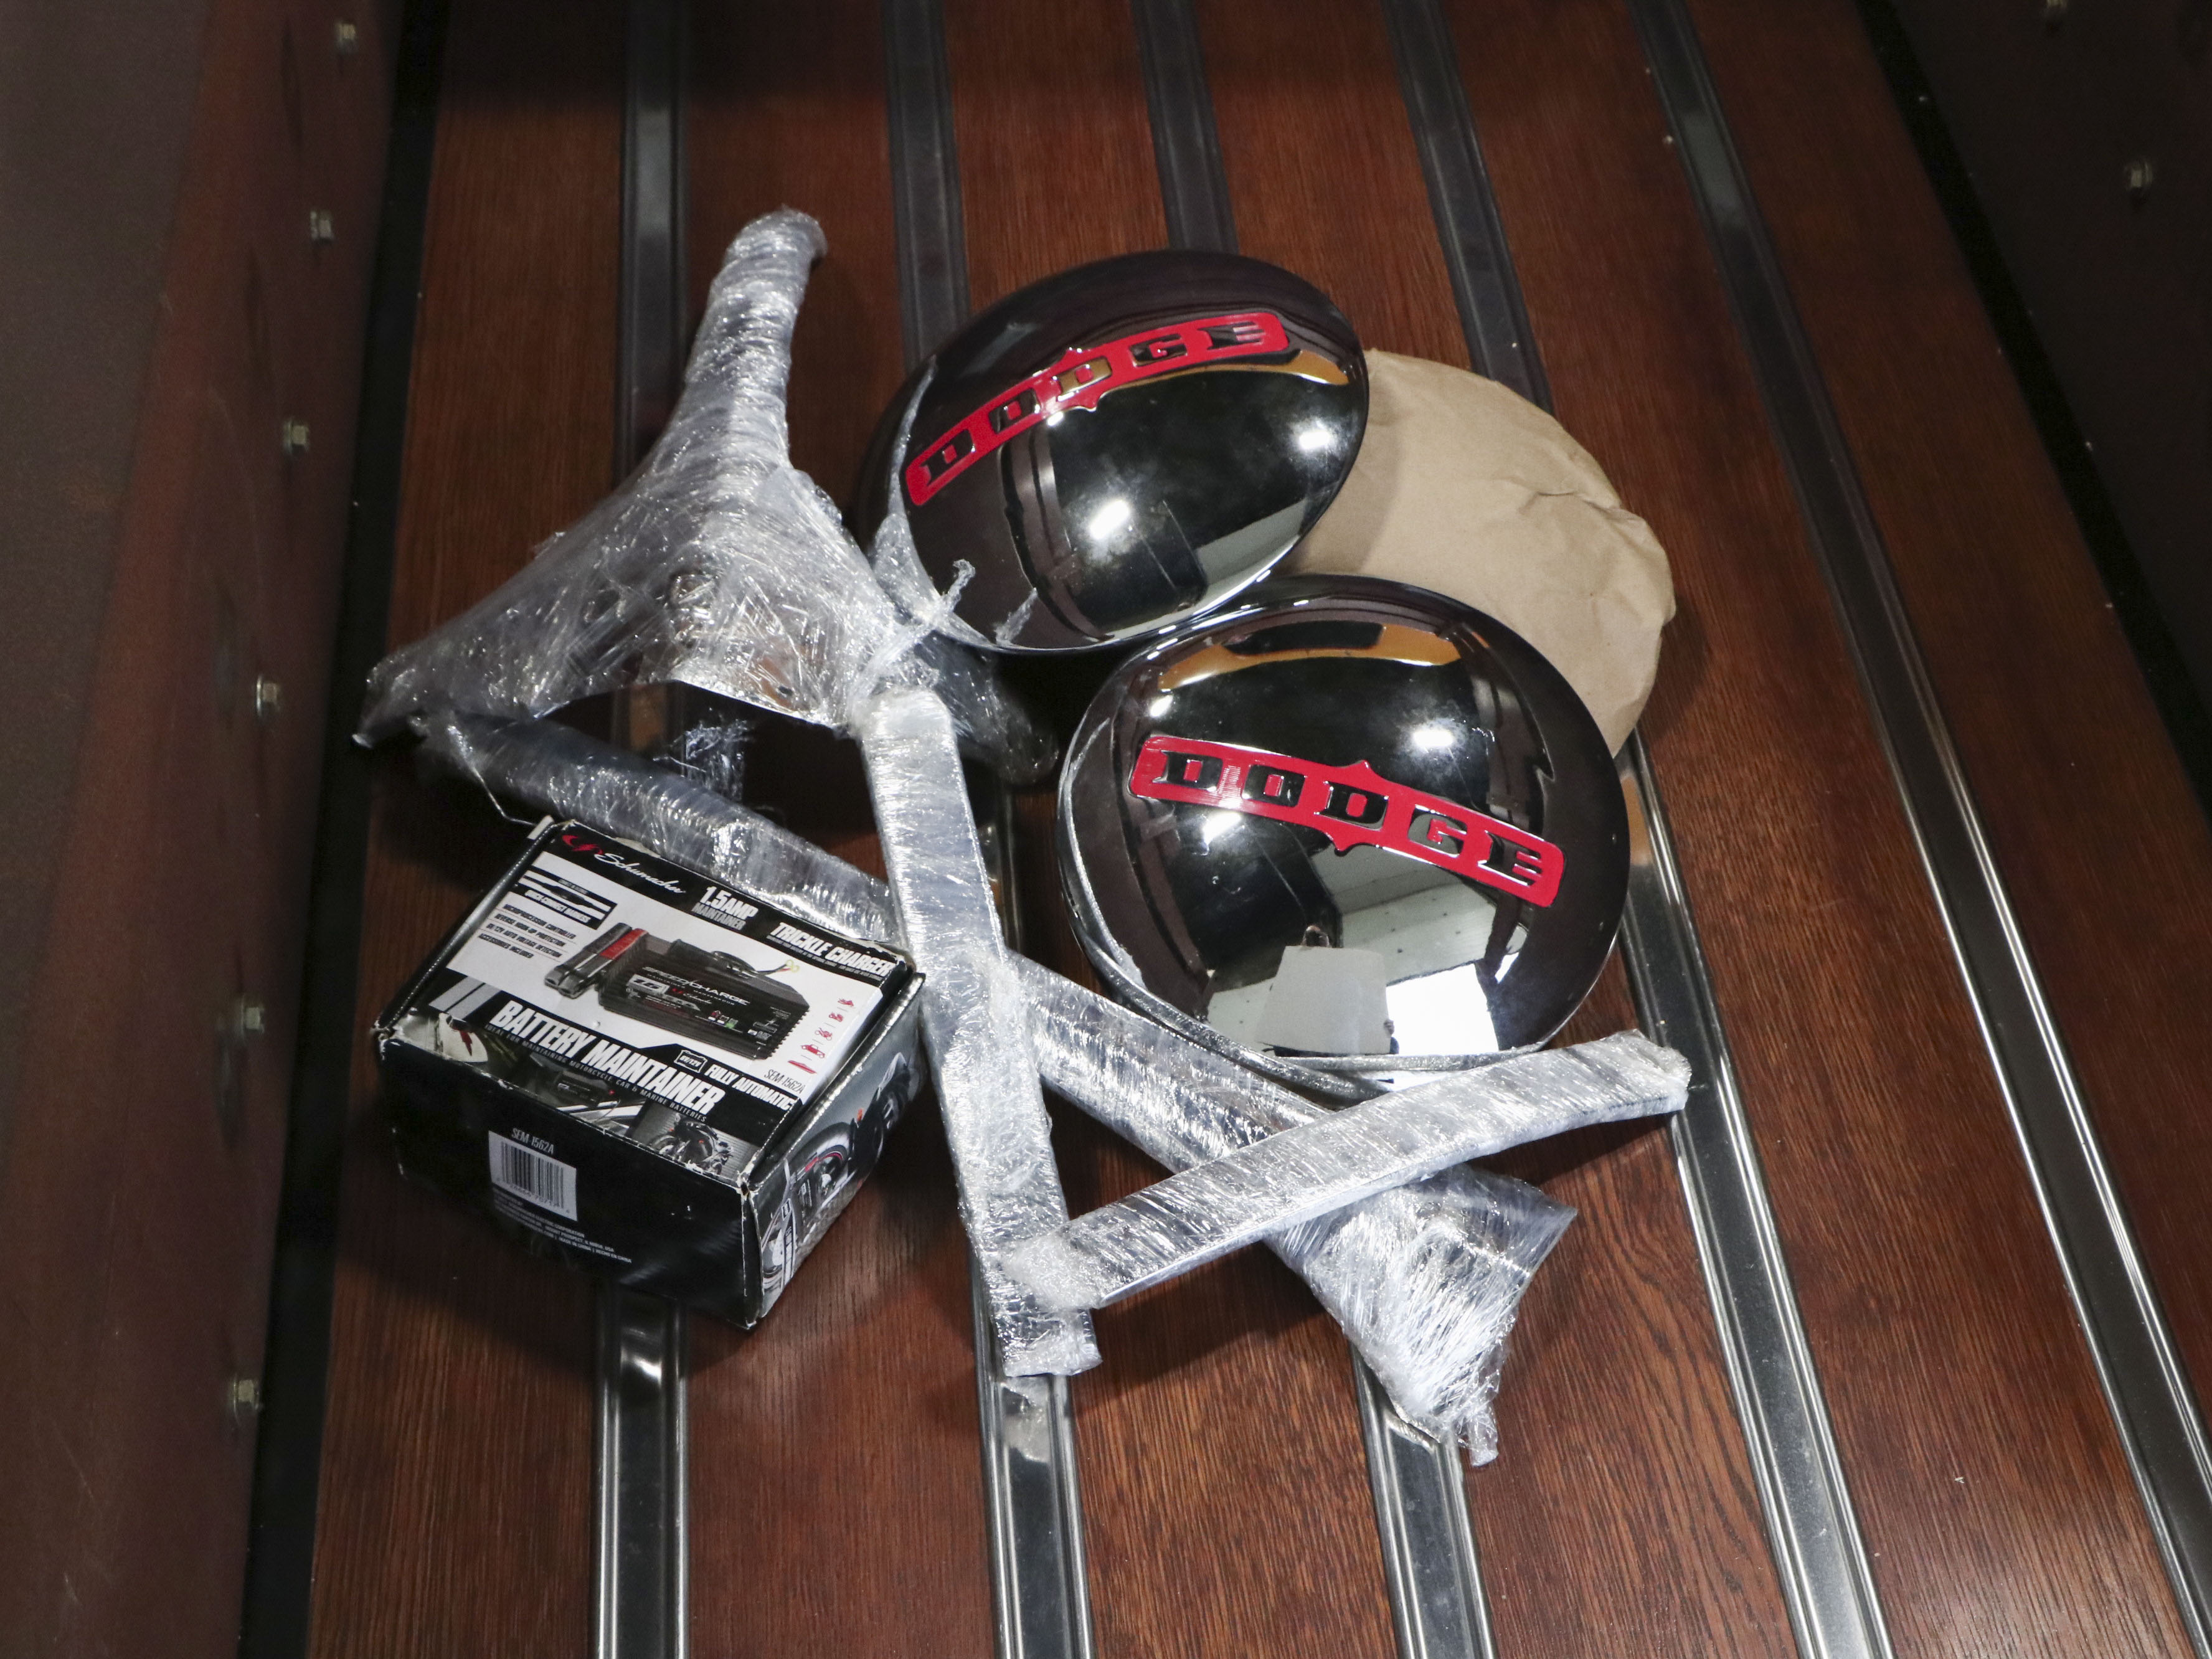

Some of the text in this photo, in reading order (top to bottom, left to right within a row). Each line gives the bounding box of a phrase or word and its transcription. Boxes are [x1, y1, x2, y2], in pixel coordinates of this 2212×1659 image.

[919, 320, 1266, 487] DODGE
[1152, 750, 1543, 886] DODGE
[593, 853, 686, 893] Schumacher
[691, 902, 746, 930] MAINTAINER
[699, 886, 759, 920] 1.5AMP
[770, 922, 833, 957] TRICKLE
[824, 945, 897, 977] CHARGER
[488, 1000, 726, 1115] BATTERY MAINTAINER
[506, 1031, 521, 1044] FOR
[522, 1039, 566, 1063] MAINTAINING
[569, 1060, 613, 1083] MOTORCYCLE
[615, 1079, 630, 1091] CAR
[639, 1088, 668, 1107] MARINE
[668, 1102, 707, 1123] BATTERIES
[763, 1069, 807, 1094] SEM-1562A
[703, 1063, 796, 1112] FULLY AUTOMATIC
